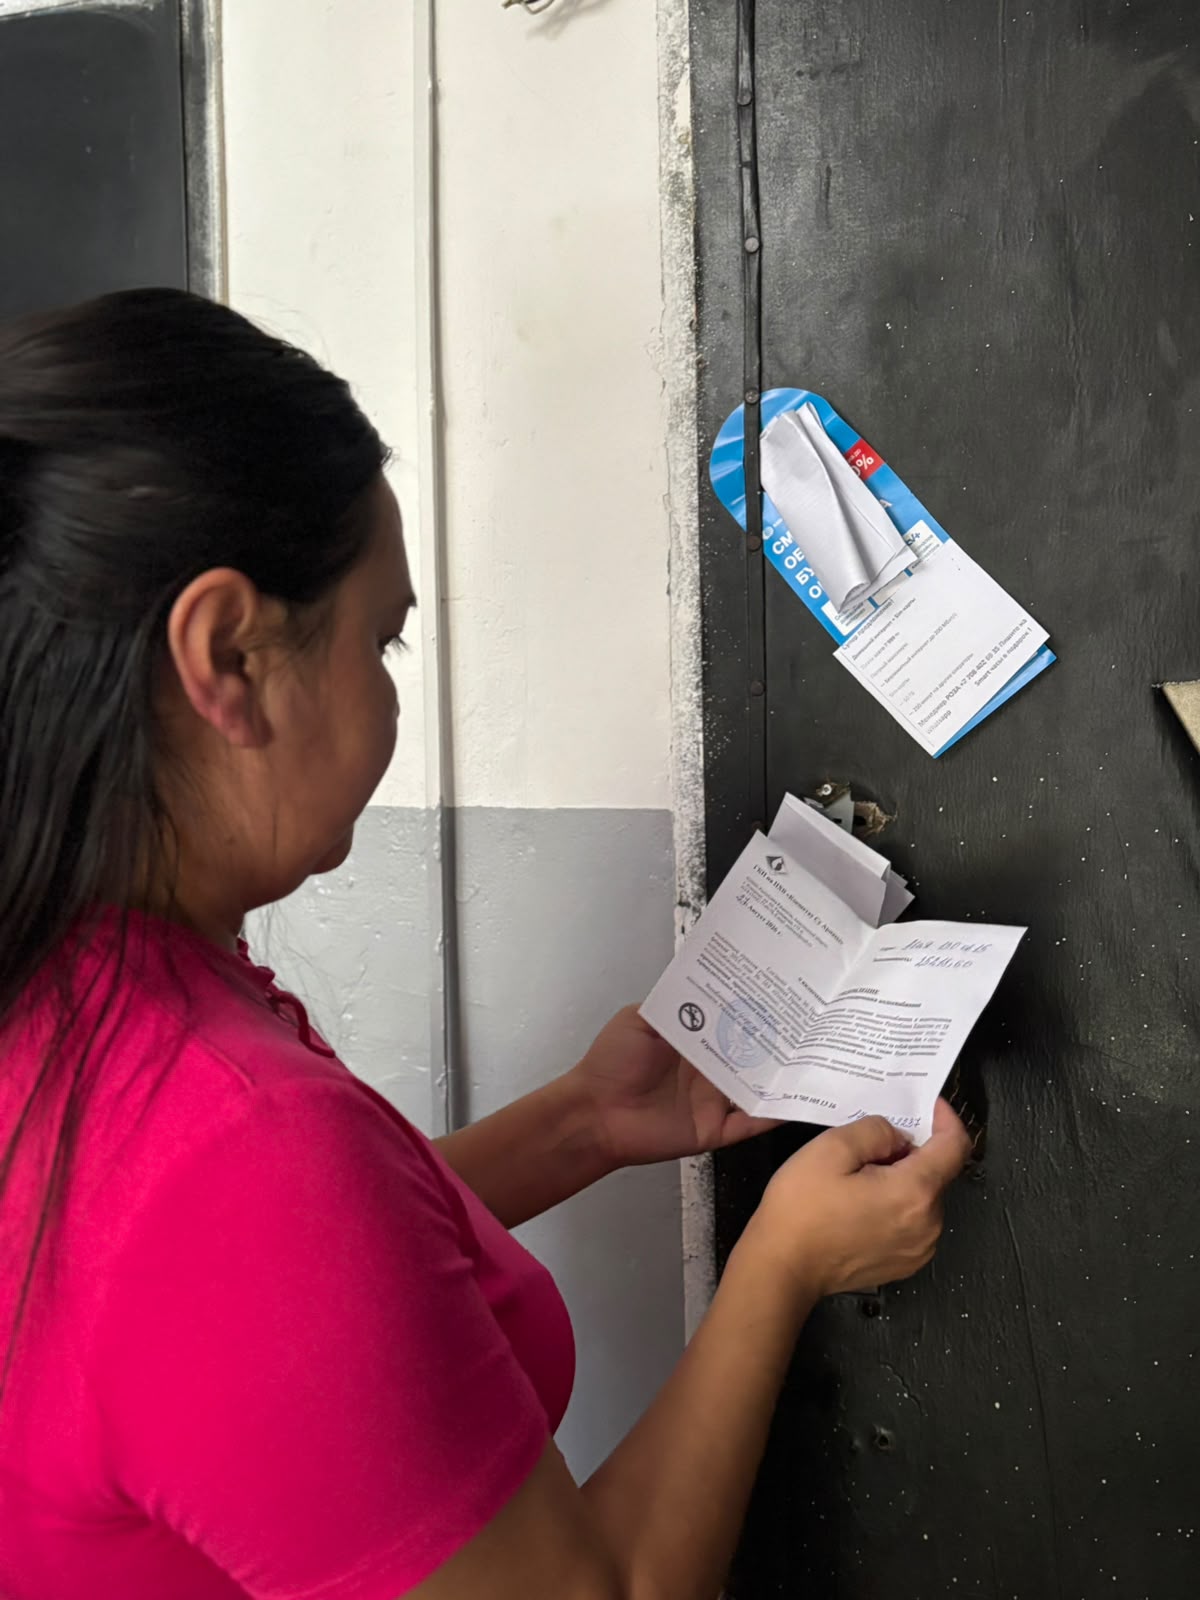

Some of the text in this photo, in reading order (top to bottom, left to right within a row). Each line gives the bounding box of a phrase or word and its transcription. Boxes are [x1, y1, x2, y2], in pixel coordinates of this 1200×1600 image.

[772, 531, 794, 555] СМ
[796, 566, 814, 585] БУ
[945, 685, 960, 699] РОЗА
